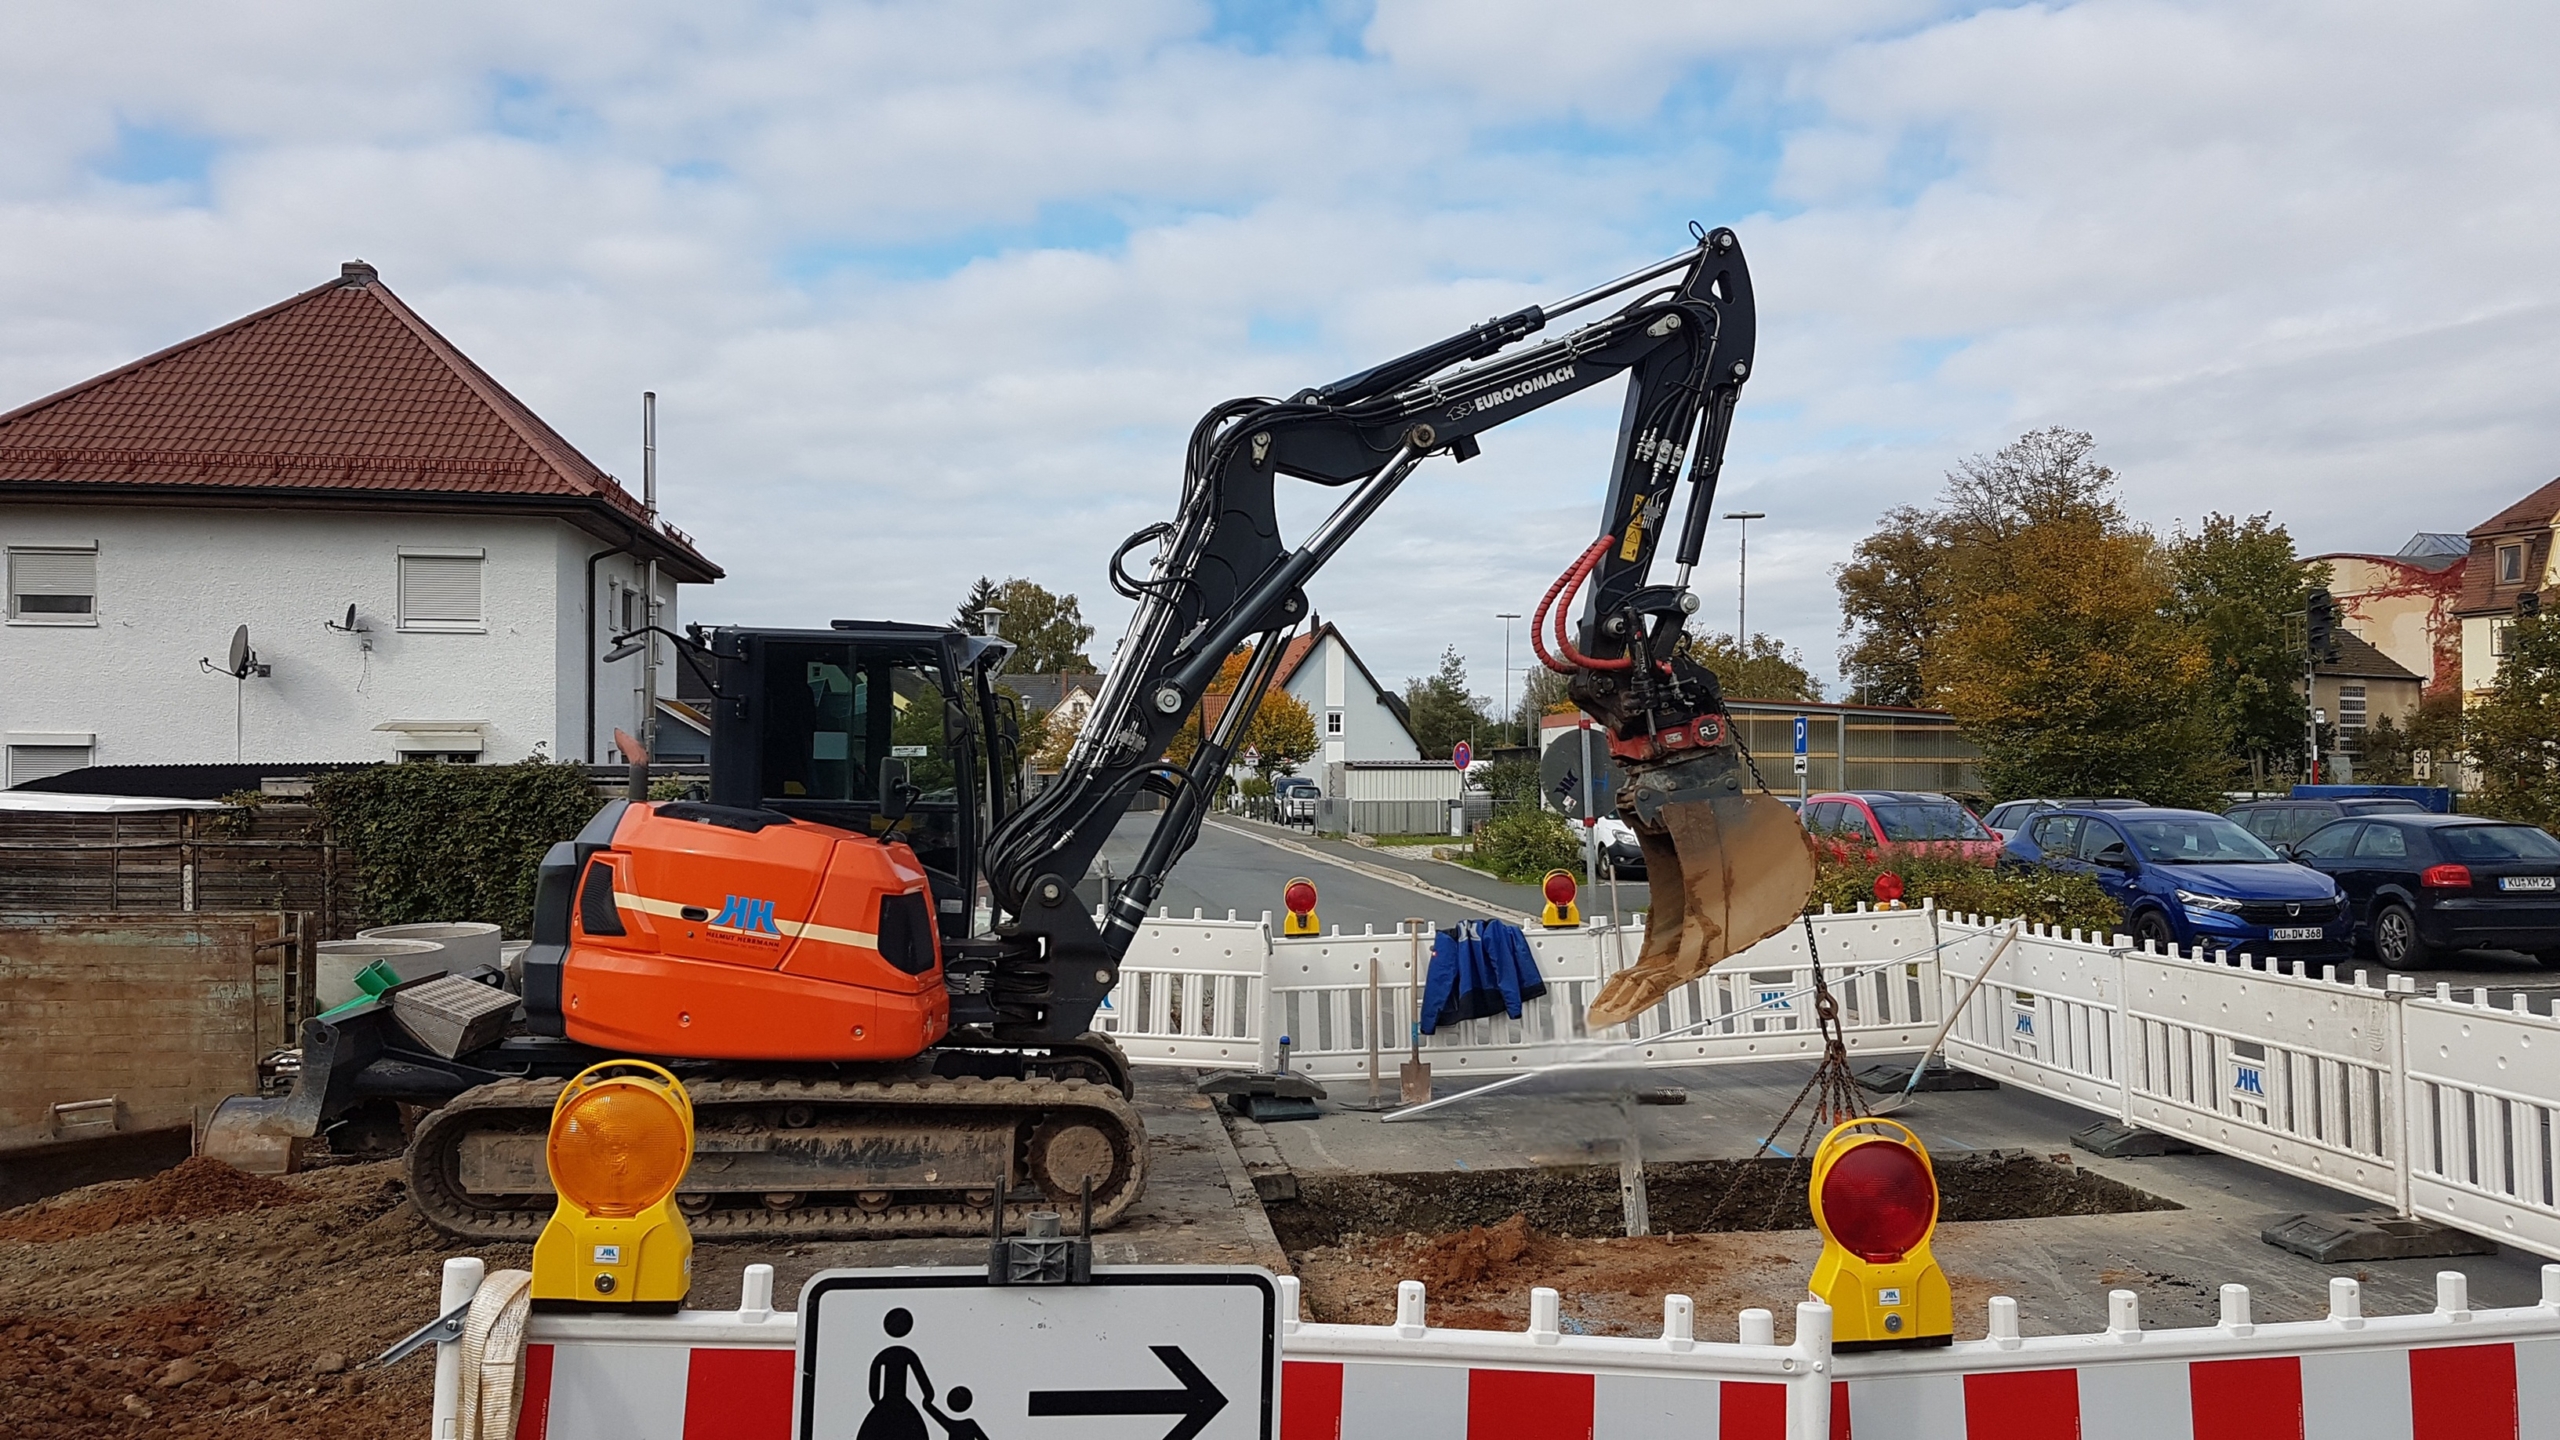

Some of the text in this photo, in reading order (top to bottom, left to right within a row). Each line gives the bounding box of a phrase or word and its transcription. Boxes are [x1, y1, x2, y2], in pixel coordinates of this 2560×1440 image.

[1474, 365, 1575, 411] EUROCOMACH
[1700, 723, 1718, 737] R3
[1796, 721, 1804, 750] P
[2414, 751, 2429, 764] 56
[2417, 764, 2425, 778] 4
[2541, 877, 2552, 887] 22
[710, 894, 779, 934] HH
[705, 931, 735, 941] HELMUT
[736, 935, 780, 948] HERRMANN
[2273, 928, 2321, 939] KU DW 368
[2015, 1013, 2035, 1035] HH
[2234, 1066, 2265, 1095] HH
